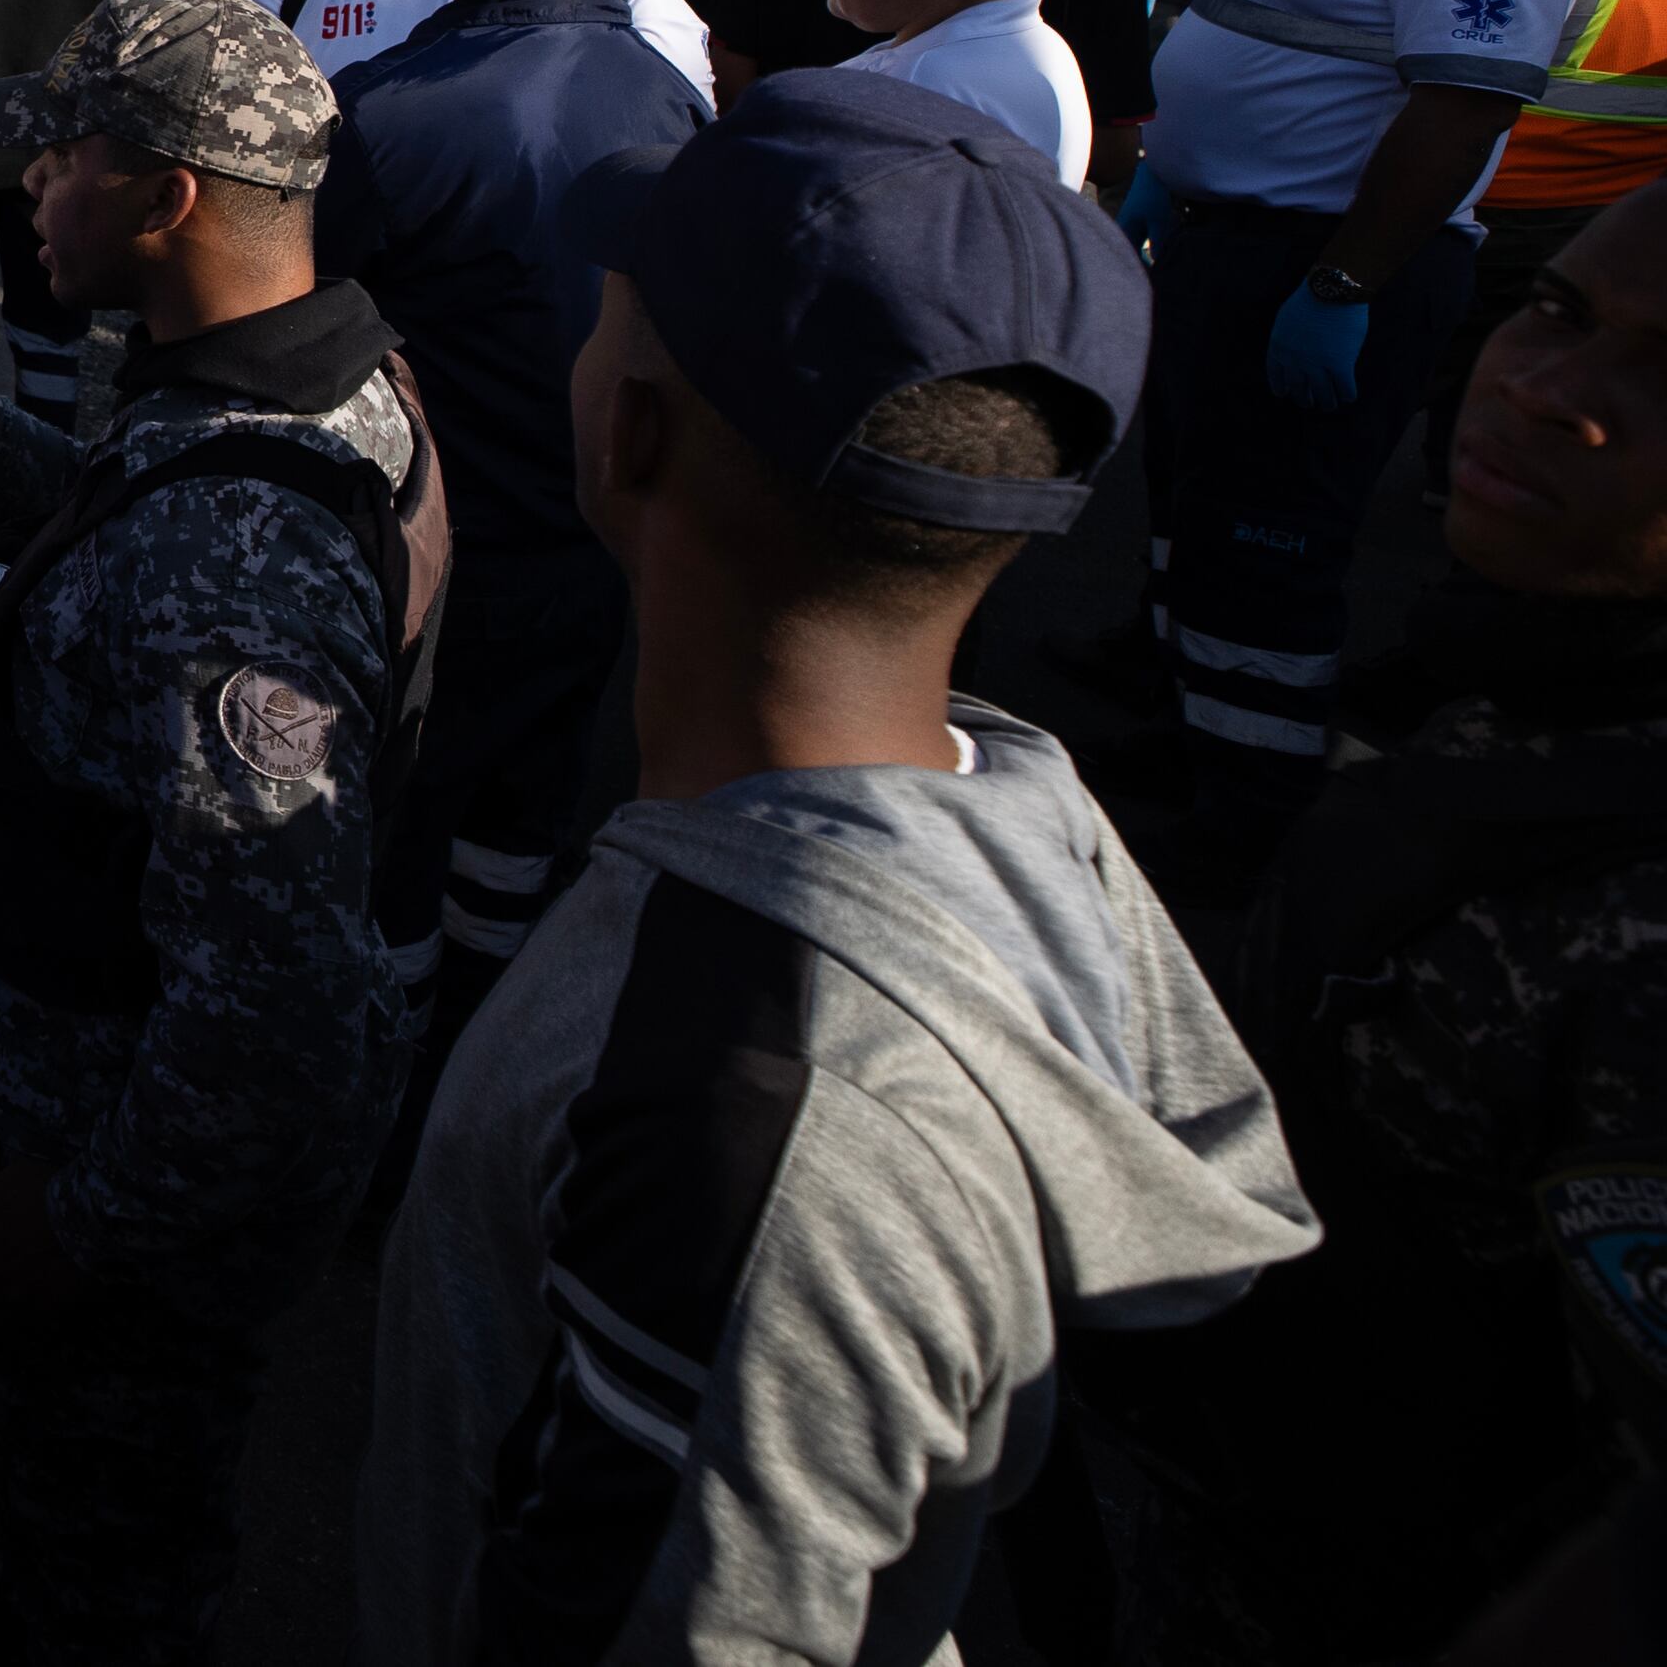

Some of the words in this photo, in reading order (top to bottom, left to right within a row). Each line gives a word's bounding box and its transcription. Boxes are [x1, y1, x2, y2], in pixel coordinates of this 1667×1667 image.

[321, 3, 364, 40] 911
[1451, 28, 1504, 44] CRUE
[267, 761, 302, 777] PABLO
[1565, 1177, 1667, 1204] POLIC
